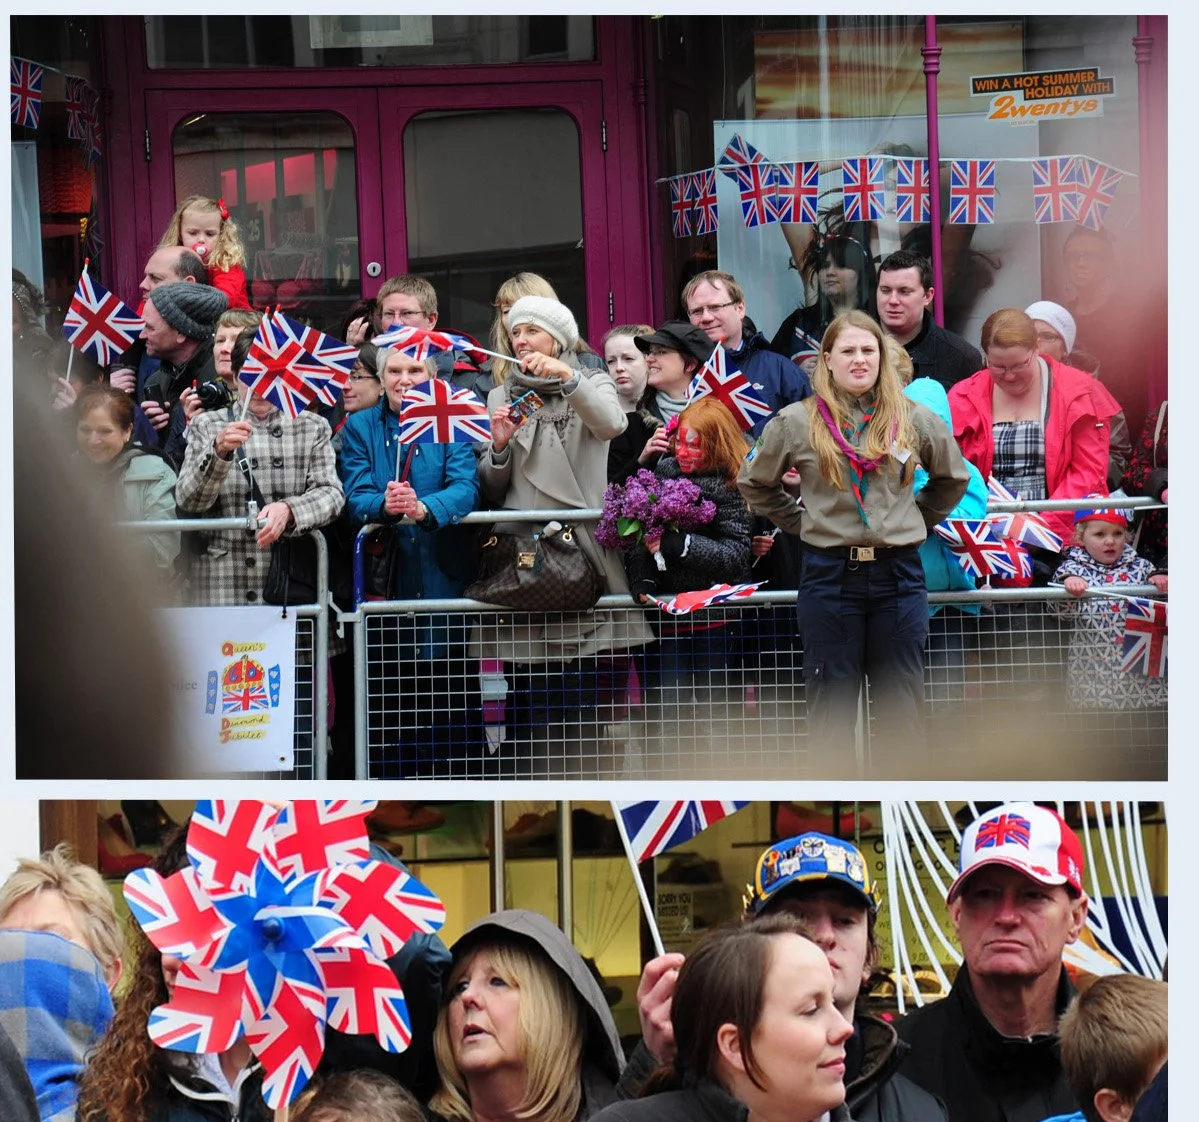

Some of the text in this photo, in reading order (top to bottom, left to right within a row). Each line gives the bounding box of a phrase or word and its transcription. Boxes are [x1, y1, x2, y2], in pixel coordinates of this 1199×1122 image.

[974, 71, 1096, 92] WIN A HOT SUMMER
[1025, 81, 1111, 99] HOLIDAY WITH
[988, 95, 1099, 120] 2wentys
